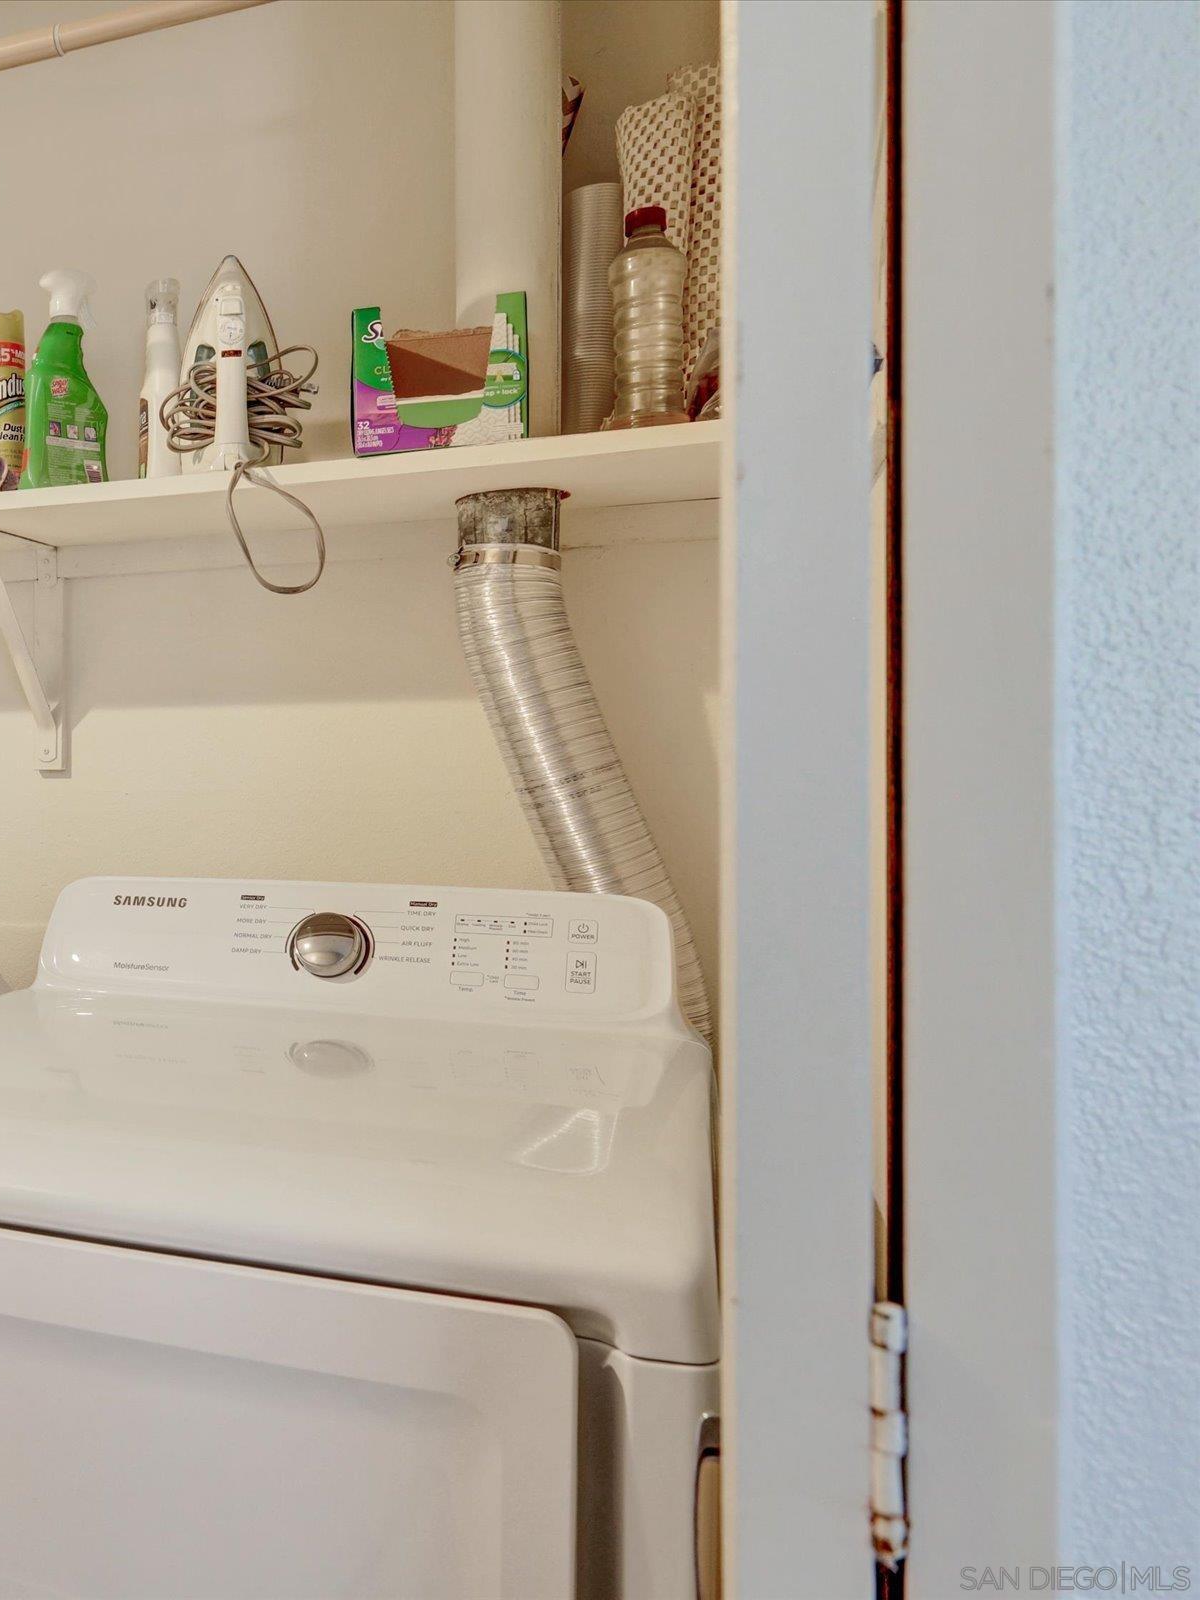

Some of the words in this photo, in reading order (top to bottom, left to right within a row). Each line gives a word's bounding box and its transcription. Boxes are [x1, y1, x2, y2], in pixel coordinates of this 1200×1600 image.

[3, 423, 22, 433] Dust
[357, 421, 370, 430] 32
[113, 894, 189, 908] SAMSUNG
[113, 961, 170, 972] MoistureSensor
